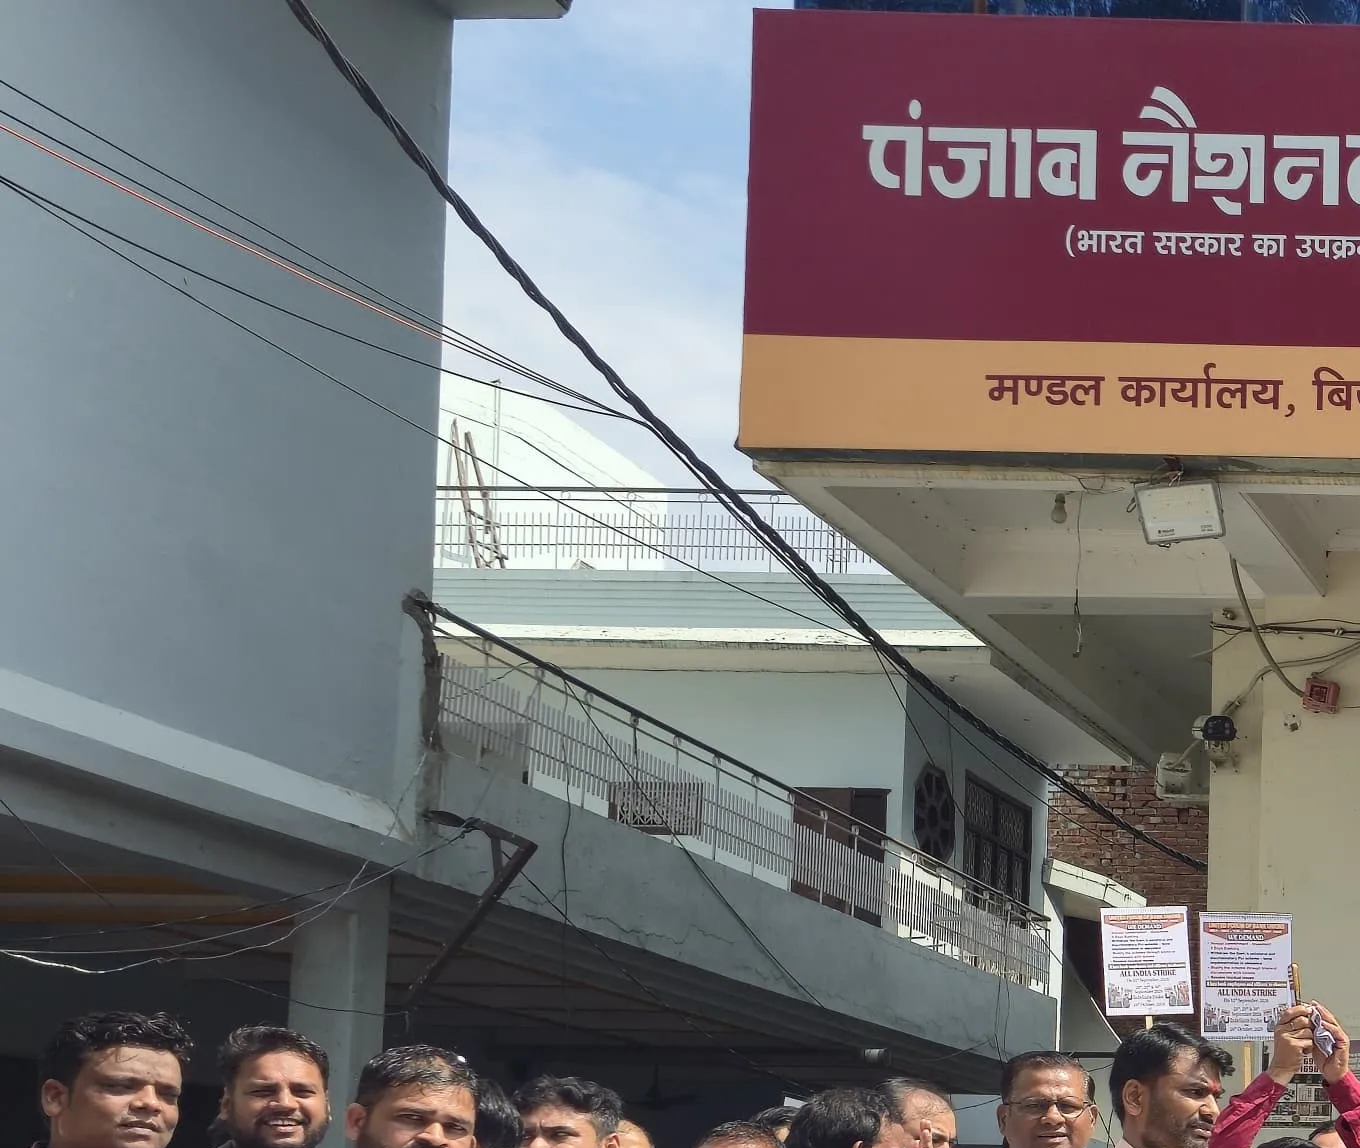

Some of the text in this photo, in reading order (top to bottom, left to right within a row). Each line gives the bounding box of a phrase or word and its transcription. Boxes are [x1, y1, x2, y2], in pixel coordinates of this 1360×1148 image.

[862, 98, 1098, 201] पंजाब
[1065, 224, 1143, 260] (भारत
[1154, 226, 1242, 260] सरकार
[1254, 229, 1285, 259] का
[987, 373, 1103, 408] मण्डल
[1117, 364, 1297, 420] कार्यालय,
[1218, 989, 1277, 997] ALL INDIA STRIKE
